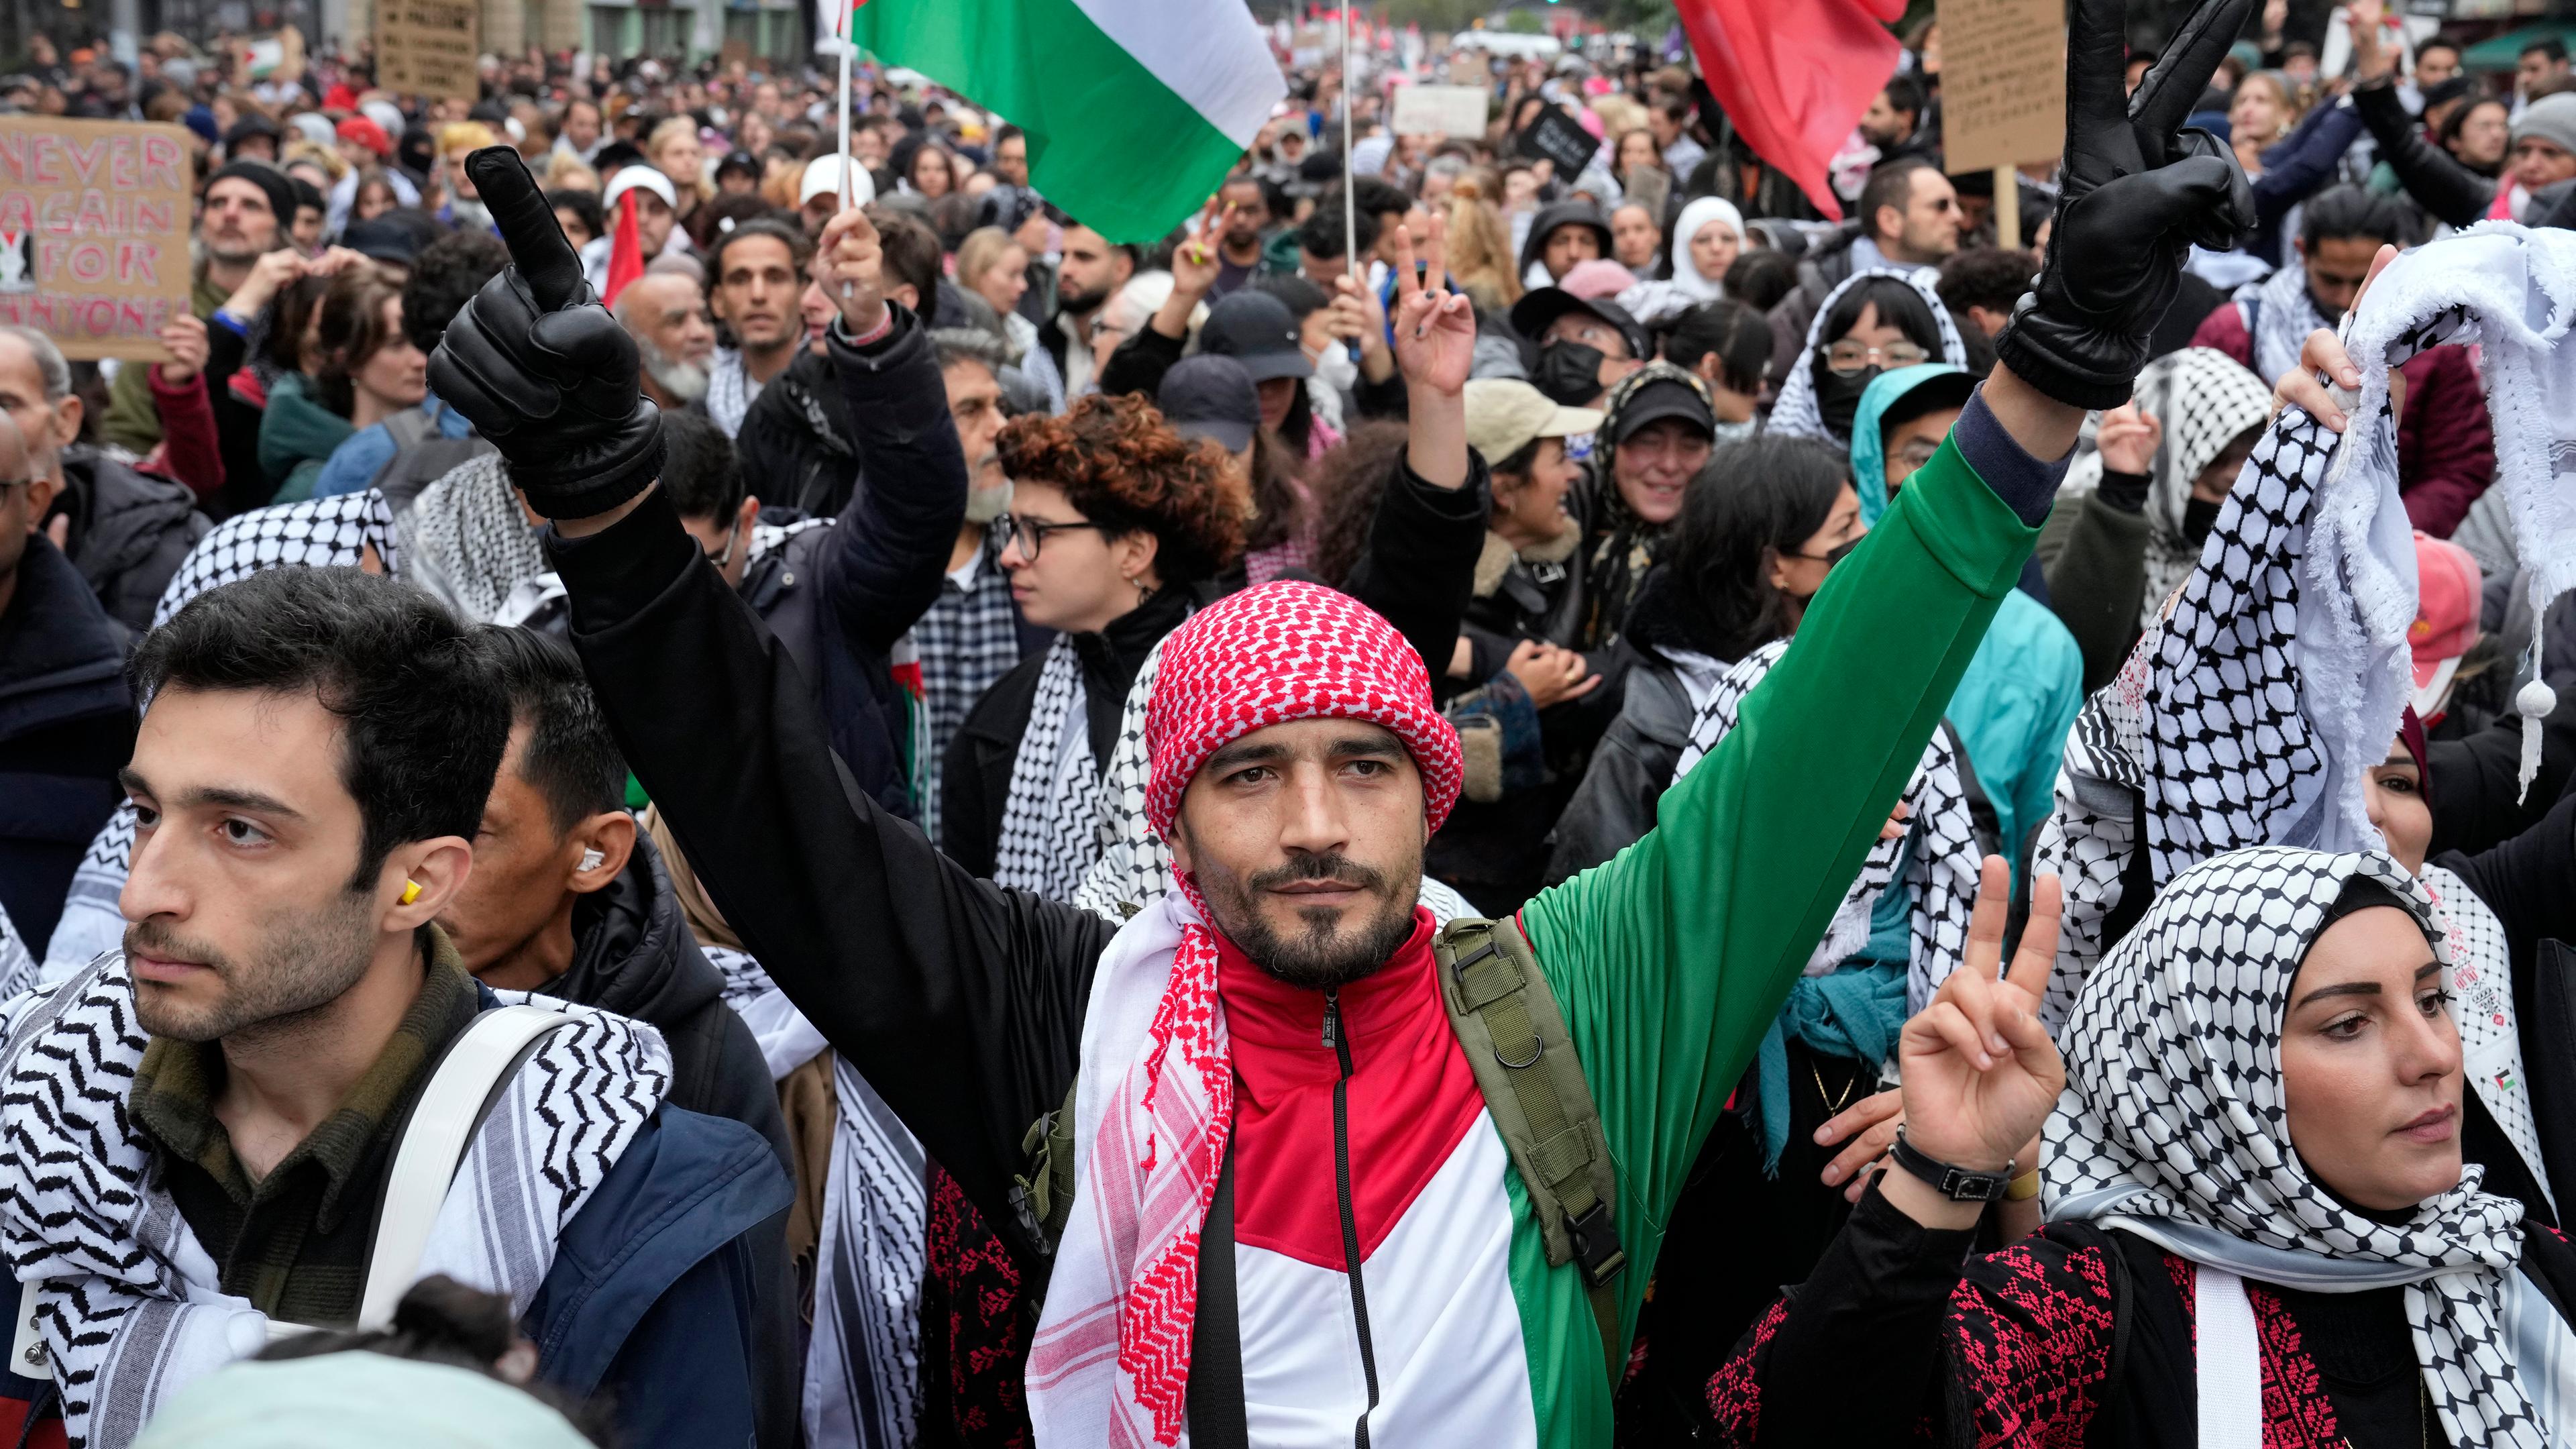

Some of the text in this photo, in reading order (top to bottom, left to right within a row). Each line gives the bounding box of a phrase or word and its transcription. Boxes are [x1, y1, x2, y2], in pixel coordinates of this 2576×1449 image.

[0, 132, 183, 191] NEVER
[0, 188, 175, 237] AGAIN
[38, 240, 162, 286] FOR
